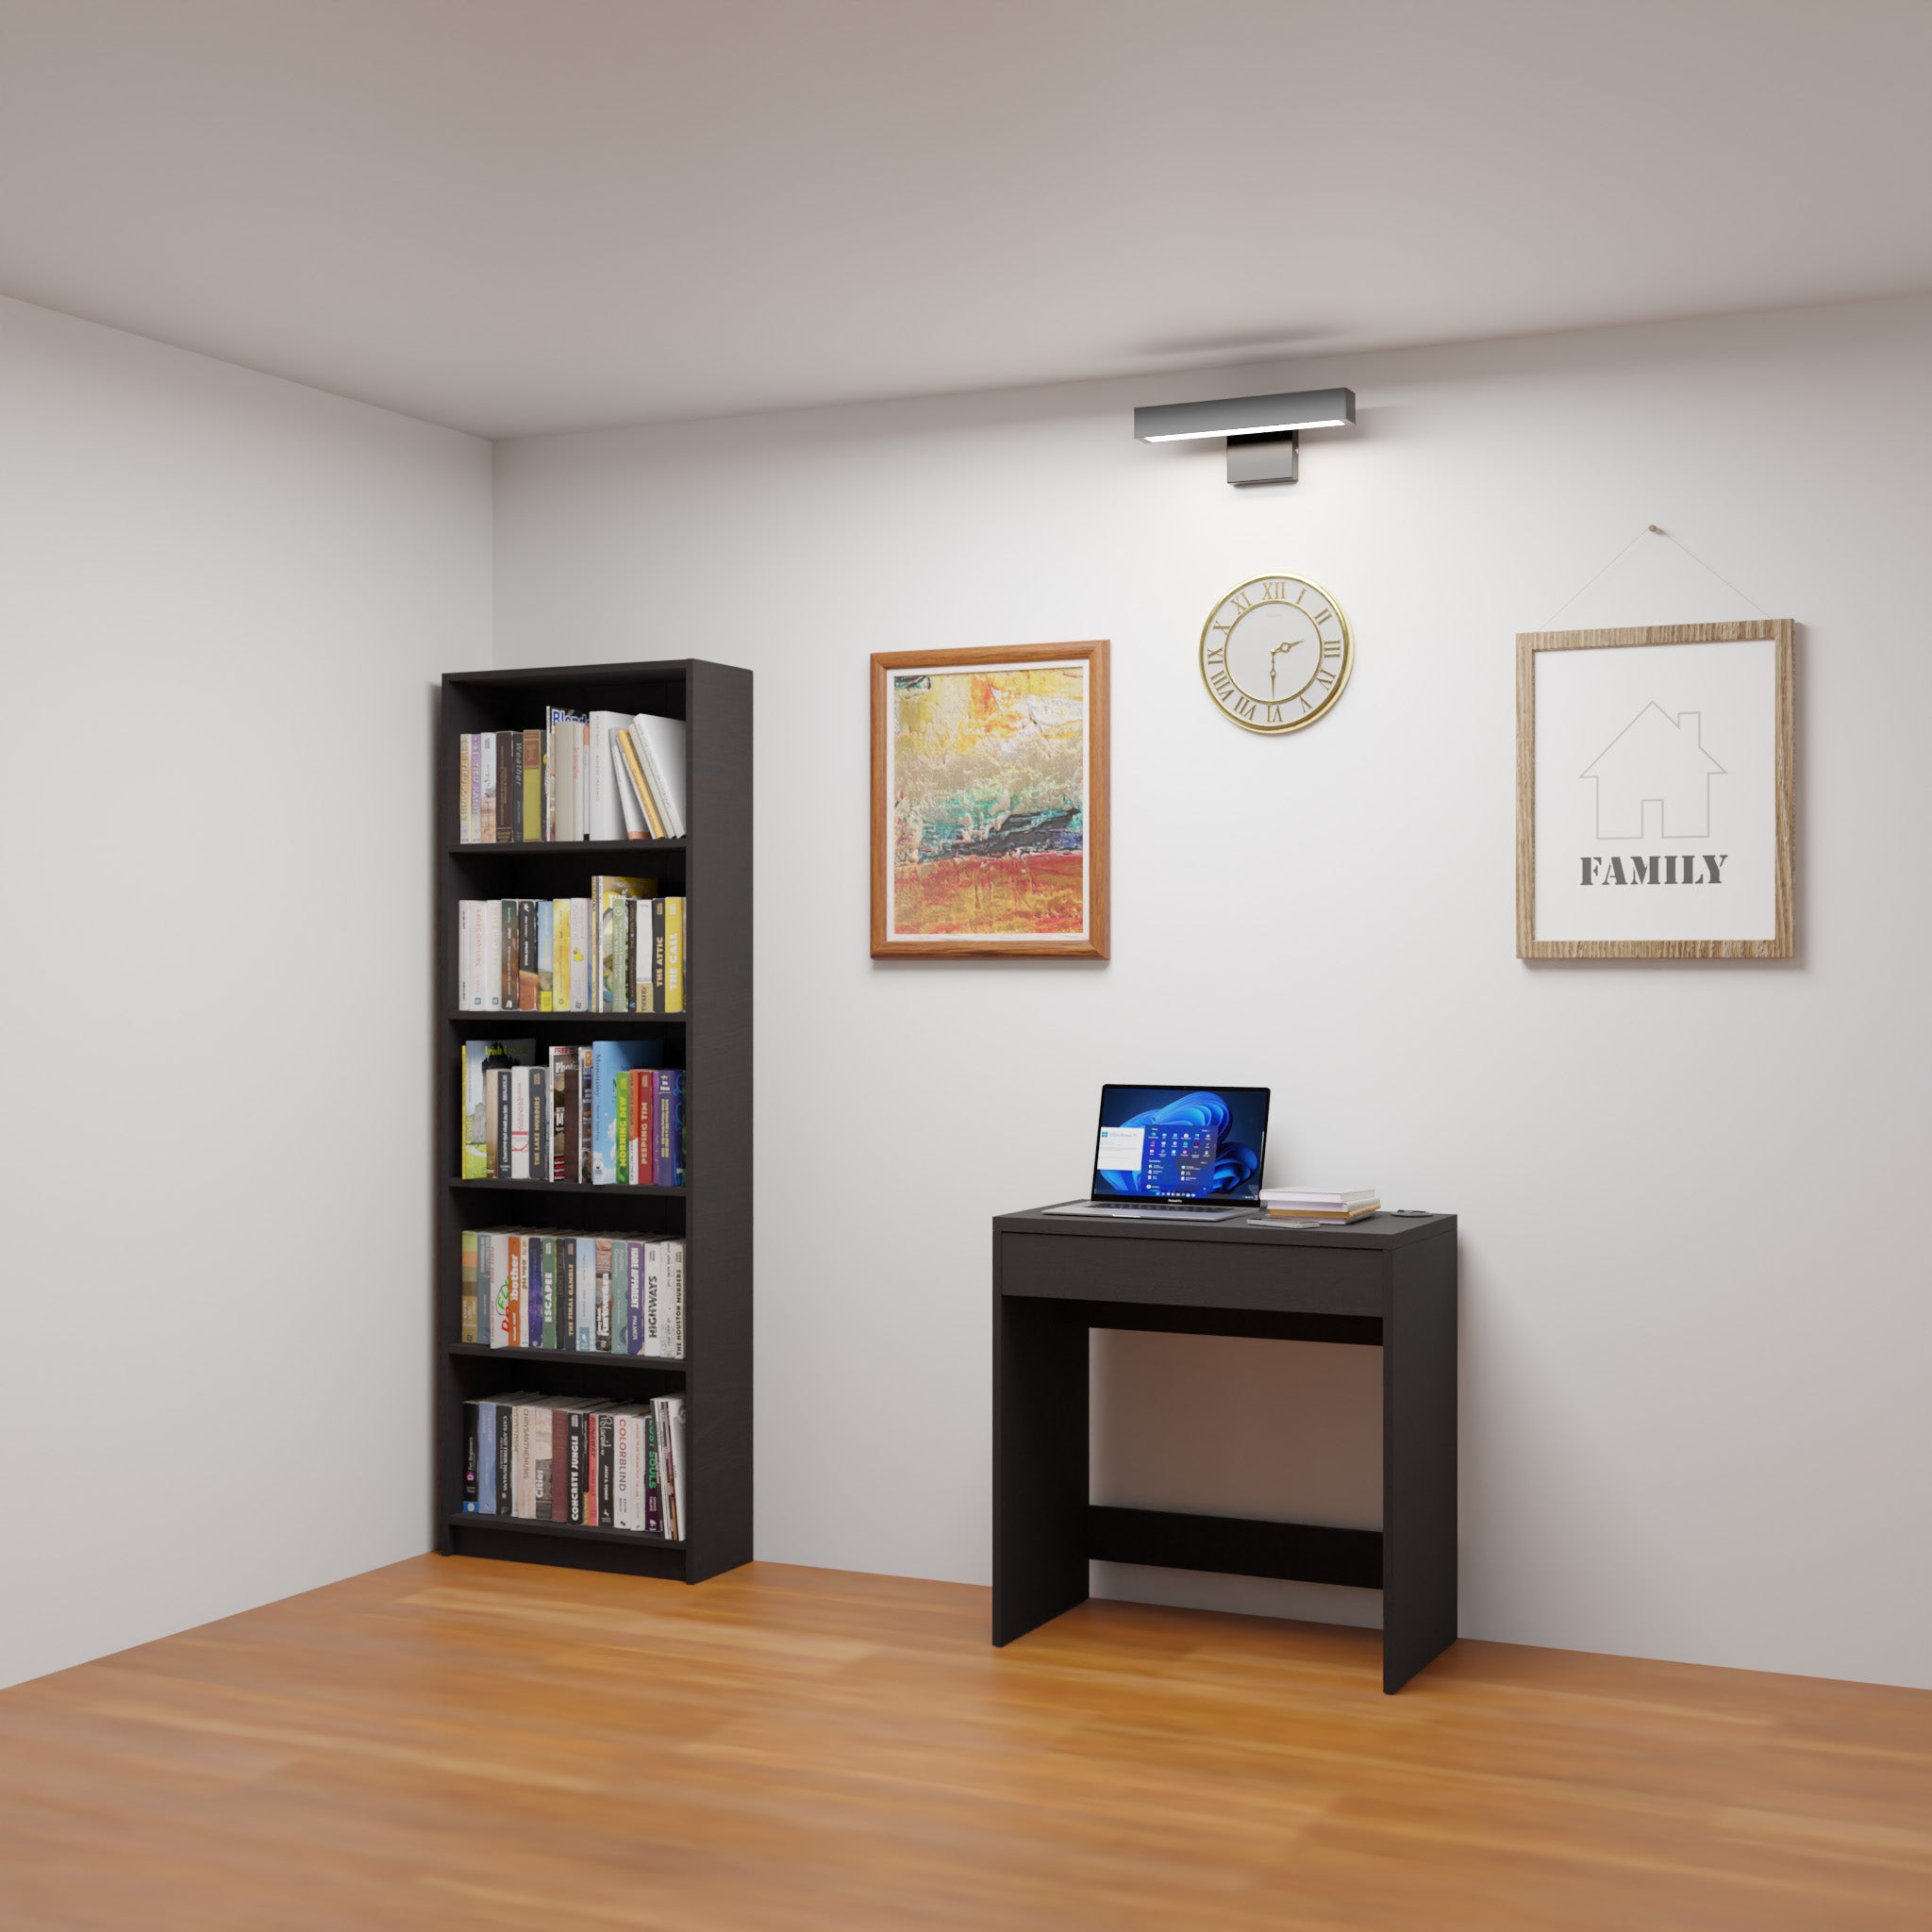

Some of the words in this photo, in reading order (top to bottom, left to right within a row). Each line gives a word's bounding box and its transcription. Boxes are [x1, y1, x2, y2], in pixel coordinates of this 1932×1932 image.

[1230, 591, 1253, 615] XI
[1262, 582, 1286, 600] XII
[1296, 588, 1307, 605] I
[1212, 620, 1231, 635] X
[1314, 608, 1332, 625] II
[1208, 646, 1224, 665] IX
[1324, 640, 1341, 658] III
[1210, 670, 1235, 702] VIII
[1316, 669, 1337, 691] IV
[1234, 696, 1257, 721] VII
[1266, 705, 1283, 723] VI
[1299, 694, 1314, 713] V
[1579, 855, 1728, 886] FAMILY
[669, 933, 678, 964] CALL
[669, 967, 678, 991] THE
[640, 1102, 648, 1121] TIM
[619, 1120, 627, 1167] MORNING
[640, 1123, 648, 1164] PEEPING
[630, 1247, 639, 1269] HARE
[510, 1254, 519, 1297] bother
[544, 1272, 553, 1323] ESCAPEE
[630, 1269, 639, 1309] APPARENT
[648, 1275, 658, 1339] HIGHWAYS
[619, 1419, 627, 1491] COLORBLIND
[648, 1451, 657, 1489] SOULS
[536, 1469, 544, 1498] Cities
